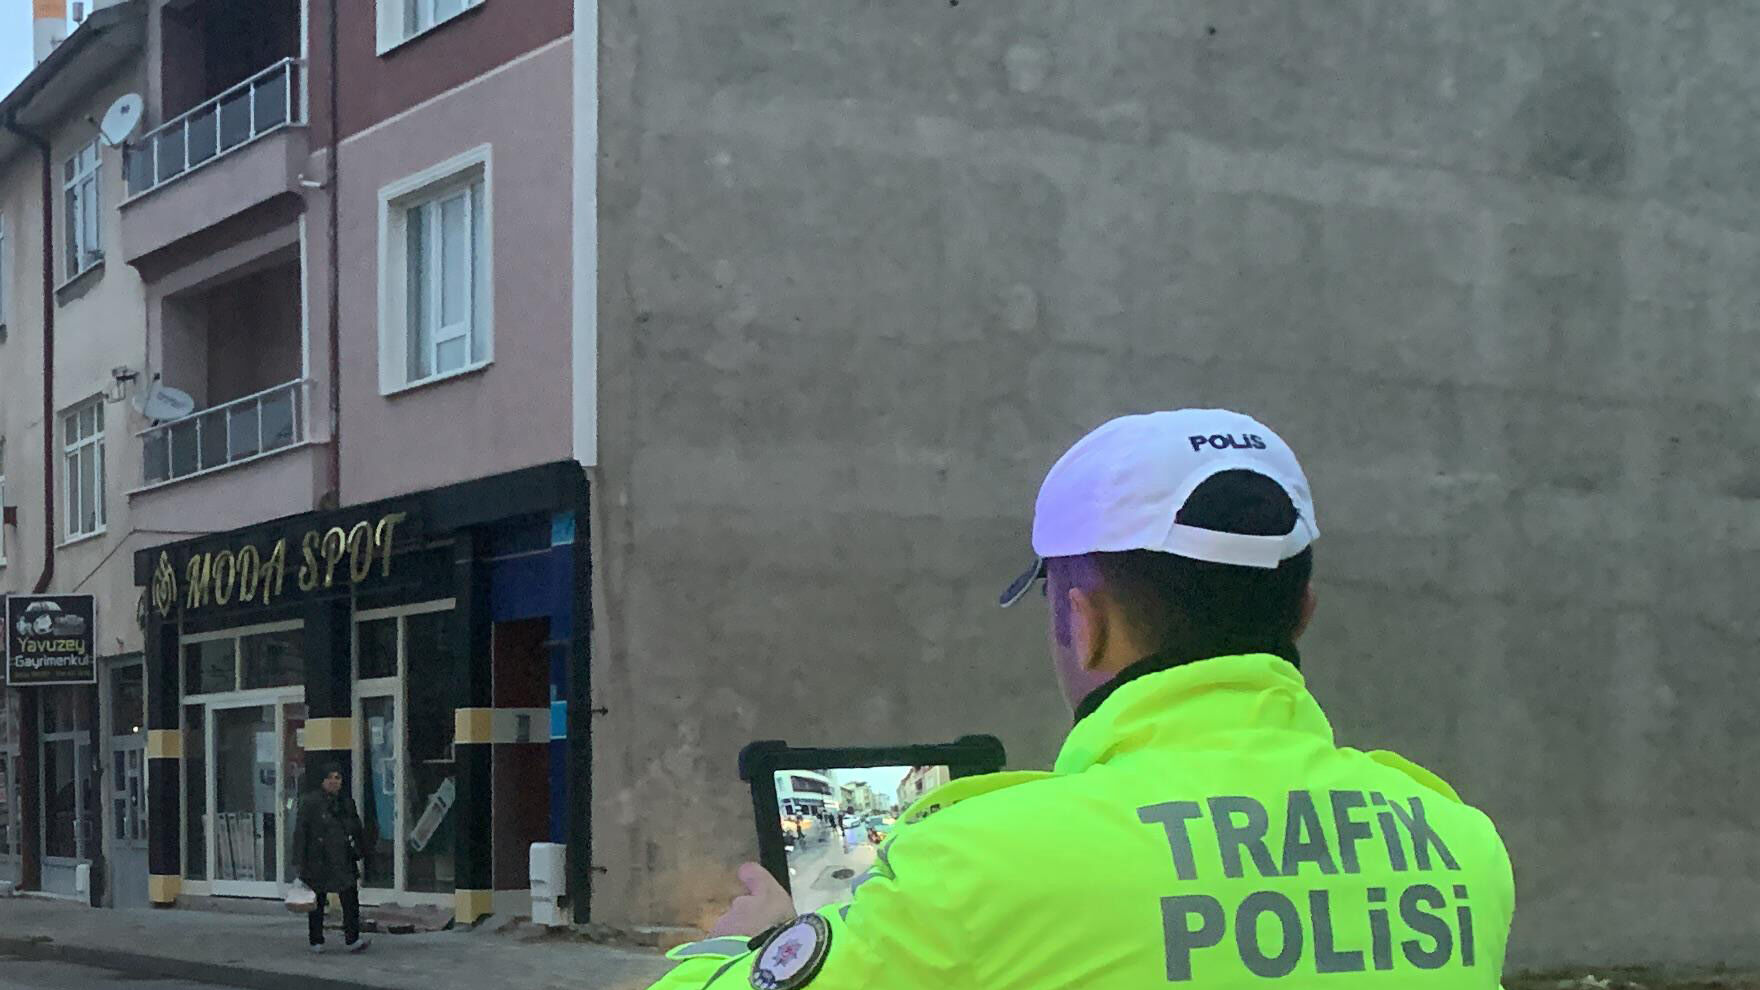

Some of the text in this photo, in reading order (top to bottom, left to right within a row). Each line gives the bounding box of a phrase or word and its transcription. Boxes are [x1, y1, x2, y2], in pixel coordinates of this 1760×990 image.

[186, 511, 407, 609] MODA SPOT
[17, 636, 86, 653] Yavuzey
[15, 653, 90, 669] Gayrimenkul
